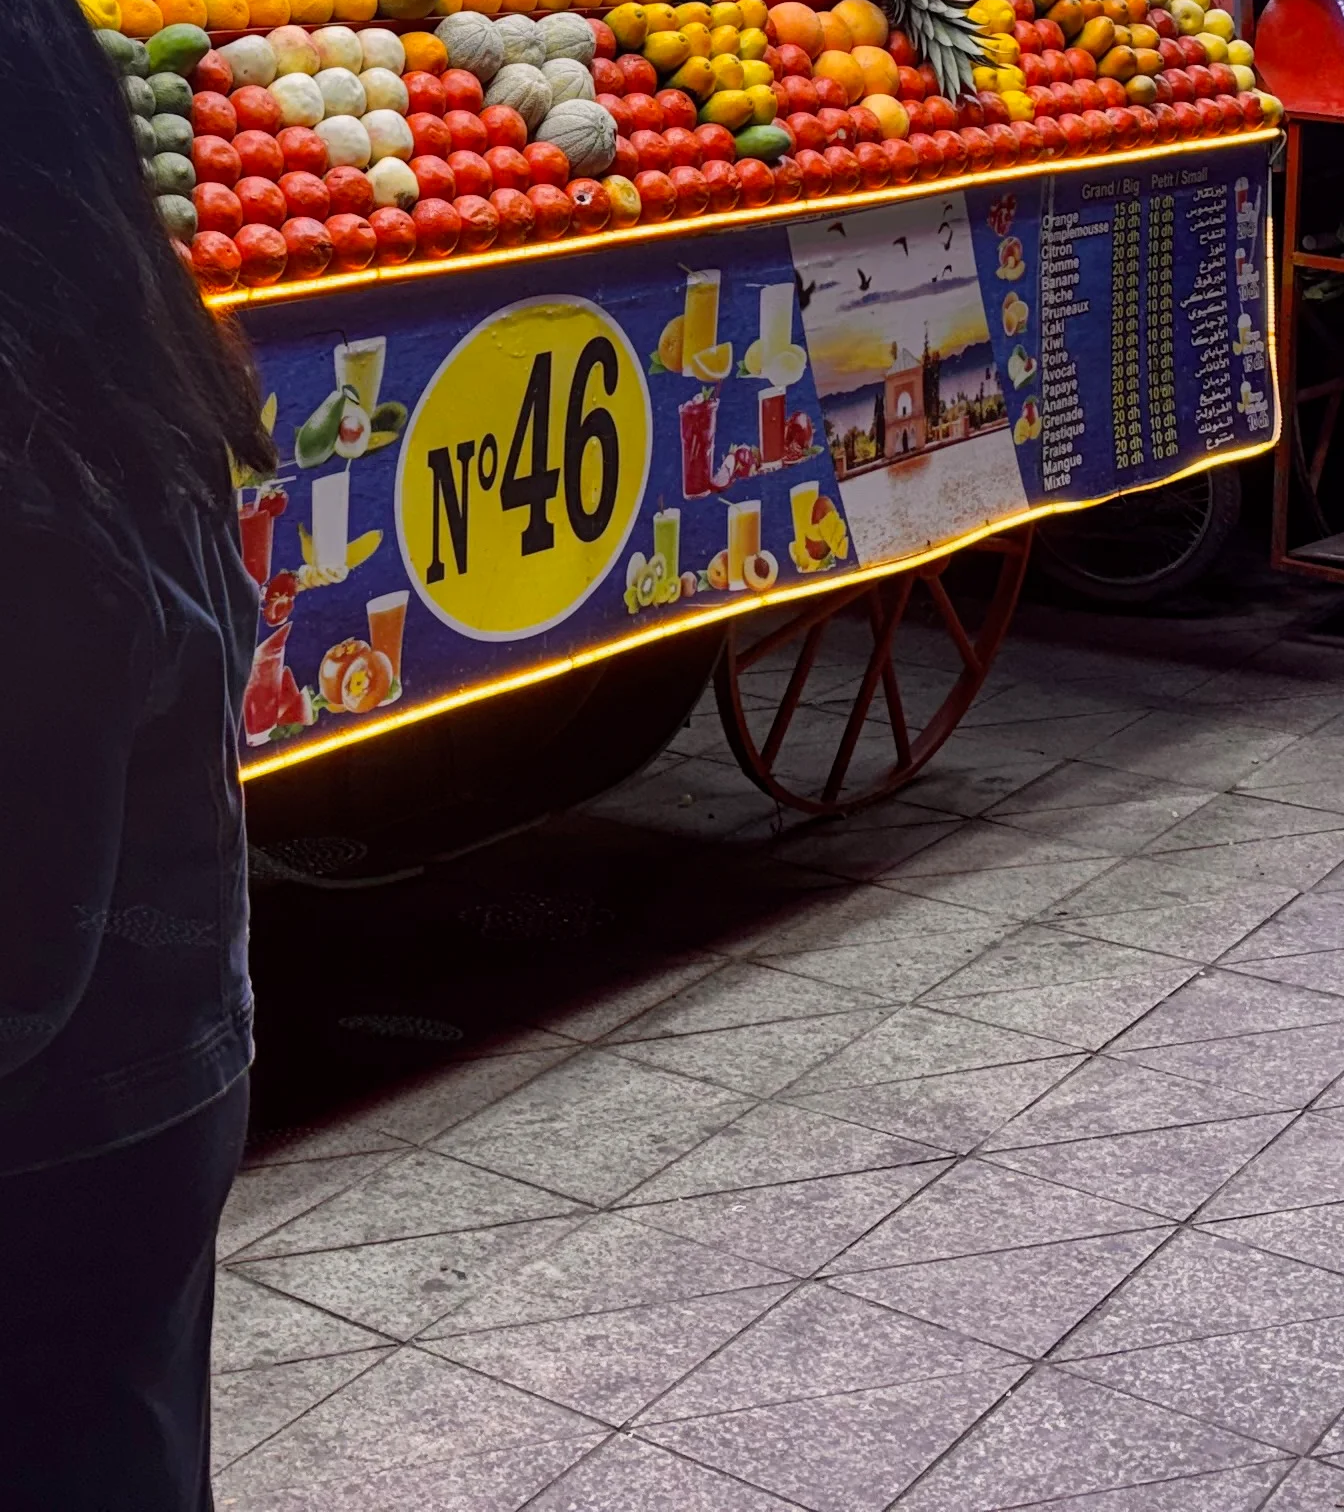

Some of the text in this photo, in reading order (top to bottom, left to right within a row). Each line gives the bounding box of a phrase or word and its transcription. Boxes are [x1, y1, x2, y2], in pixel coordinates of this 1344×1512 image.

[1081, 178, 1141, 200] Grand Big
[1151, 167, 1209, 189] Petit Small
[1042, 212, 1080, 229] Orange
[1041, 221, 1110, 244] Pomplemousse
[1041, 257, 1080, 276] Pomme
[1041, 272, 1080, 291] Banane
[1042, 300, 1090, 322] Pruneaux
[1042, 362, 1076, 384] Avocat
[1042, 378, 1078, 399] Papaye
[1042, 393, 1079, 414] Ananas
[1042, 406, 1084, 429] Grenade
[1042, 422, 1085, 446] Pastique
[426, 336, 620, 584] N°46
